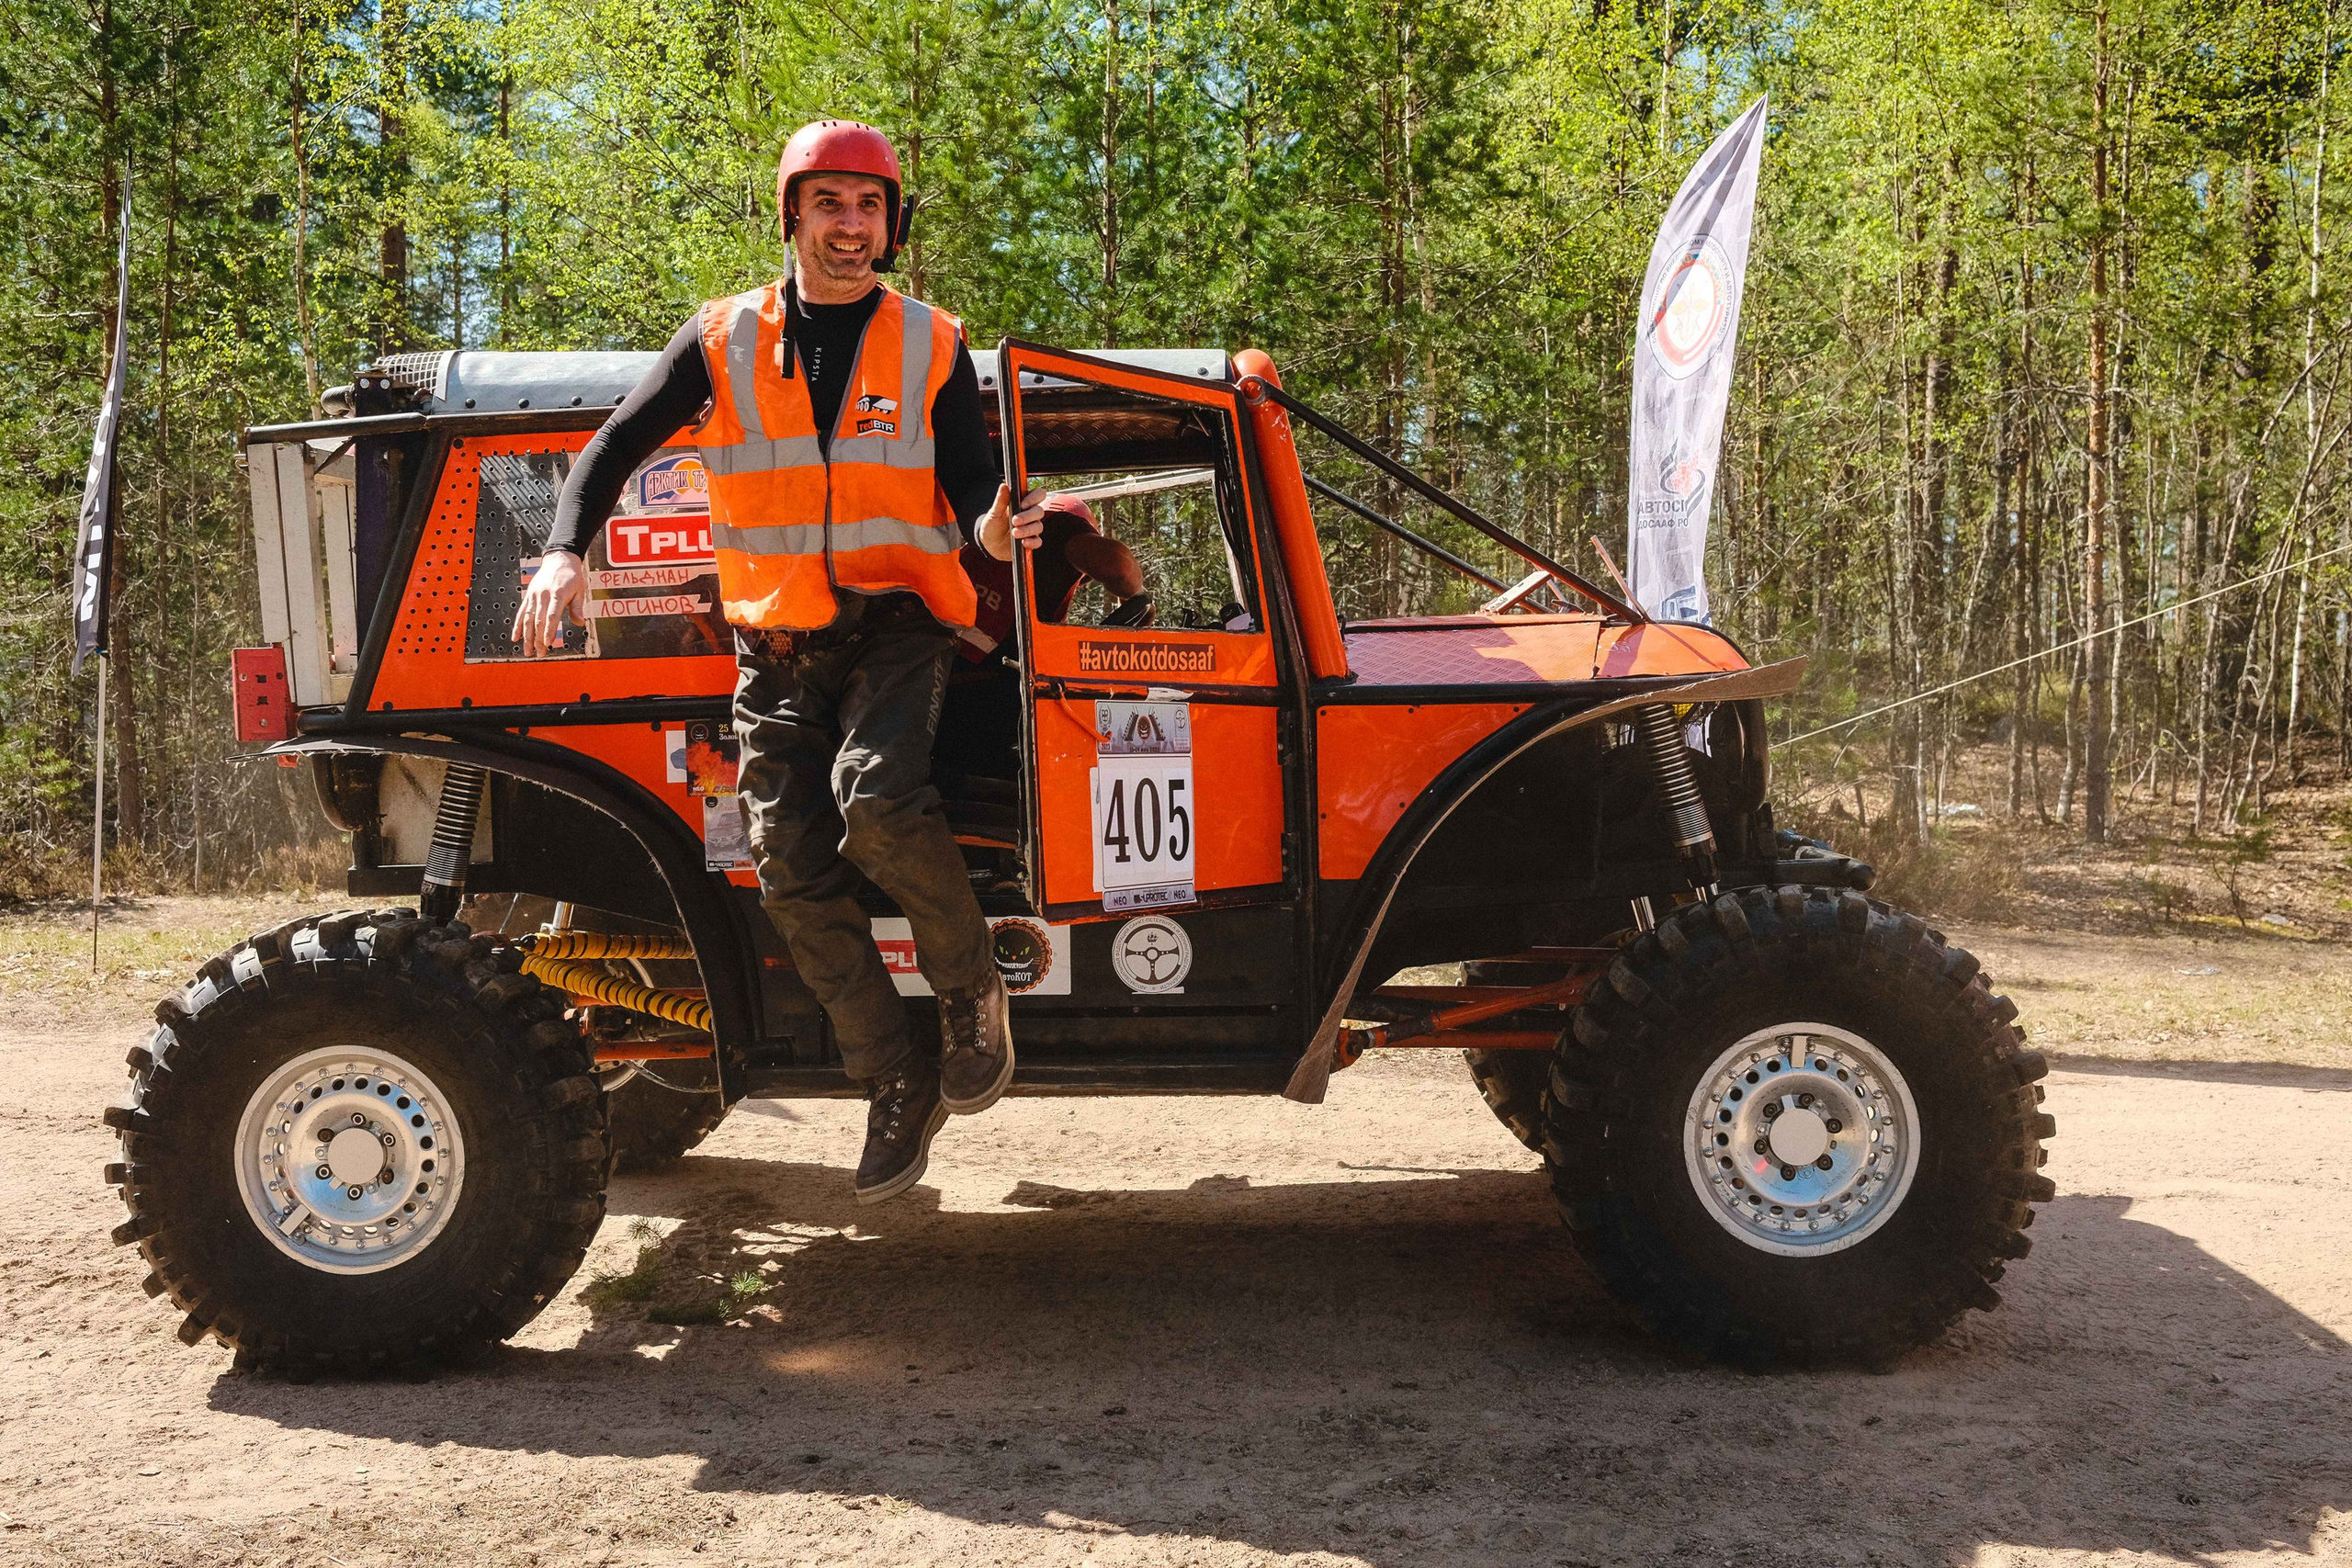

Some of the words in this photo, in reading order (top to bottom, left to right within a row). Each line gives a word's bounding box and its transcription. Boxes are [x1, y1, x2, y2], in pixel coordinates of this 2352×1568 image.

[811, 347, 822, 381] KIPSTA
[859, 420, 894, 432] redBTR
[647, 470, 688, 502] АРКТИК
[1638, 518, 1675, 530] ДОСААФ
[601, 596, 695, 617] ЛОГИНОВ
[1080, 641, 1214, 671] #avtokotdosaaf
[718, 723, 729, 733] 25
[1104, 777, 1189, 863] 405
[1114, 896, 1127, 906] NEO
[1173, 890, 1186, 900] NEO
